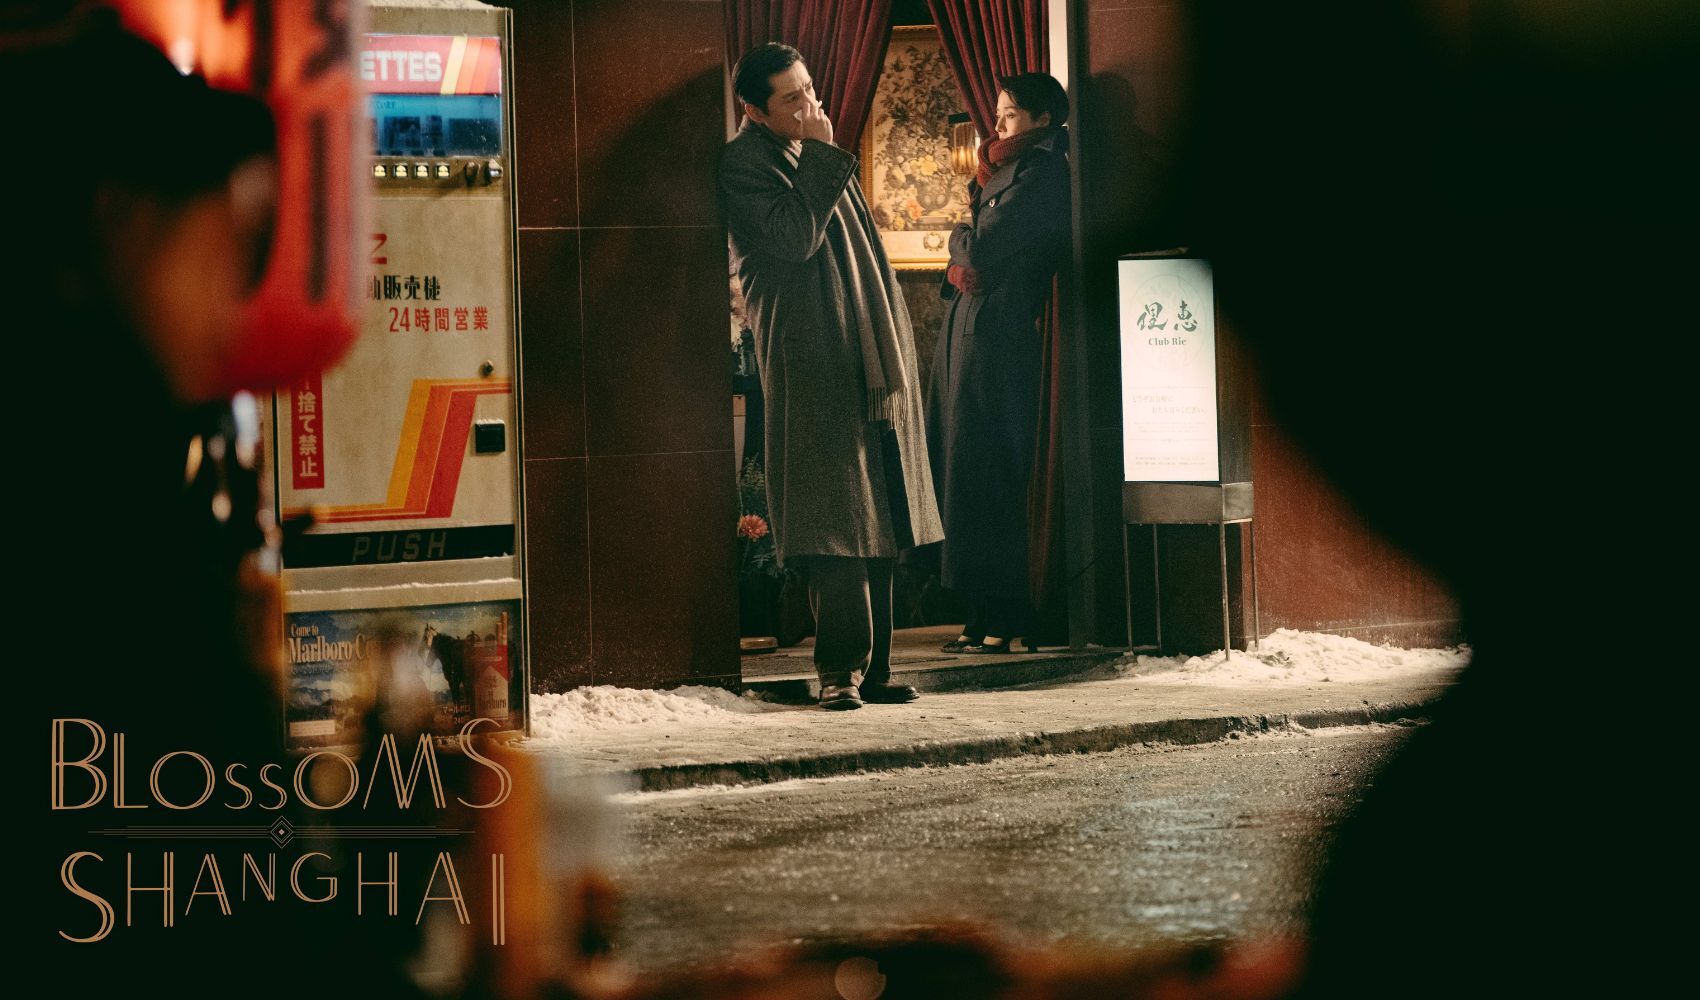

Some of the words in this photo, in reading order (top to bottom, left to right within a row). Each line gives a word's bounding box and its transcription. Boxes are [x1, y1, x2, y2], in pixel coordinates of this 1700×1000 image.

[389, 306, 489, 333] 24時間営業
[1148, 337, 1170, 346] Club
[1172, 336, 1187, 346] Rie
[298, 380, 319, 477] 捨て禁止
[352, 531, 447, 563] PUSH
[291, 623, 311, 638] Come
[311, 624, 319, 635] to
[289, 635, 353, 664] Marlboro
